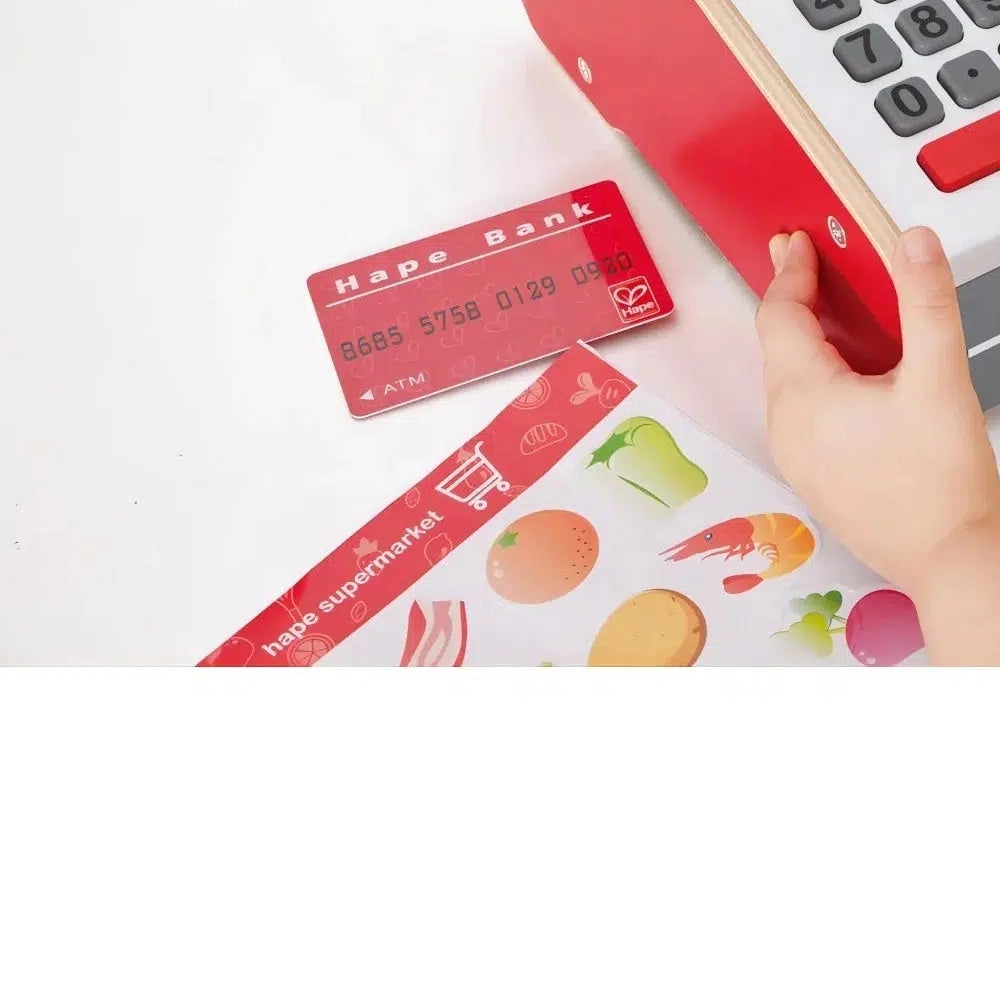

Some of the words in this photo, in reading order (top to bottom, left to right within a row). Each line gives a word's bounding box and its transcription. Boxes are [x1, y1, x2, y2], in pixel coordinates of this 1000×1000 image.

[844, 28, 877, 64] 7
[911, 5, 948, 38] 8
[890, 83, 928, 117] 0
[335, 250, 447, 294] Hape
[484, 203, 594, 246] Bank
[341, 326, 404, 361] 8685
[419, 301, 481, 335] 5758
[495, 275, 556, 310] 0129
[622, 302, 654, 317] Hape
[384, 372, 425, 395] ATM
[261, 612, 318, 656] hape
[319, 510, 444, 613] supermarket
